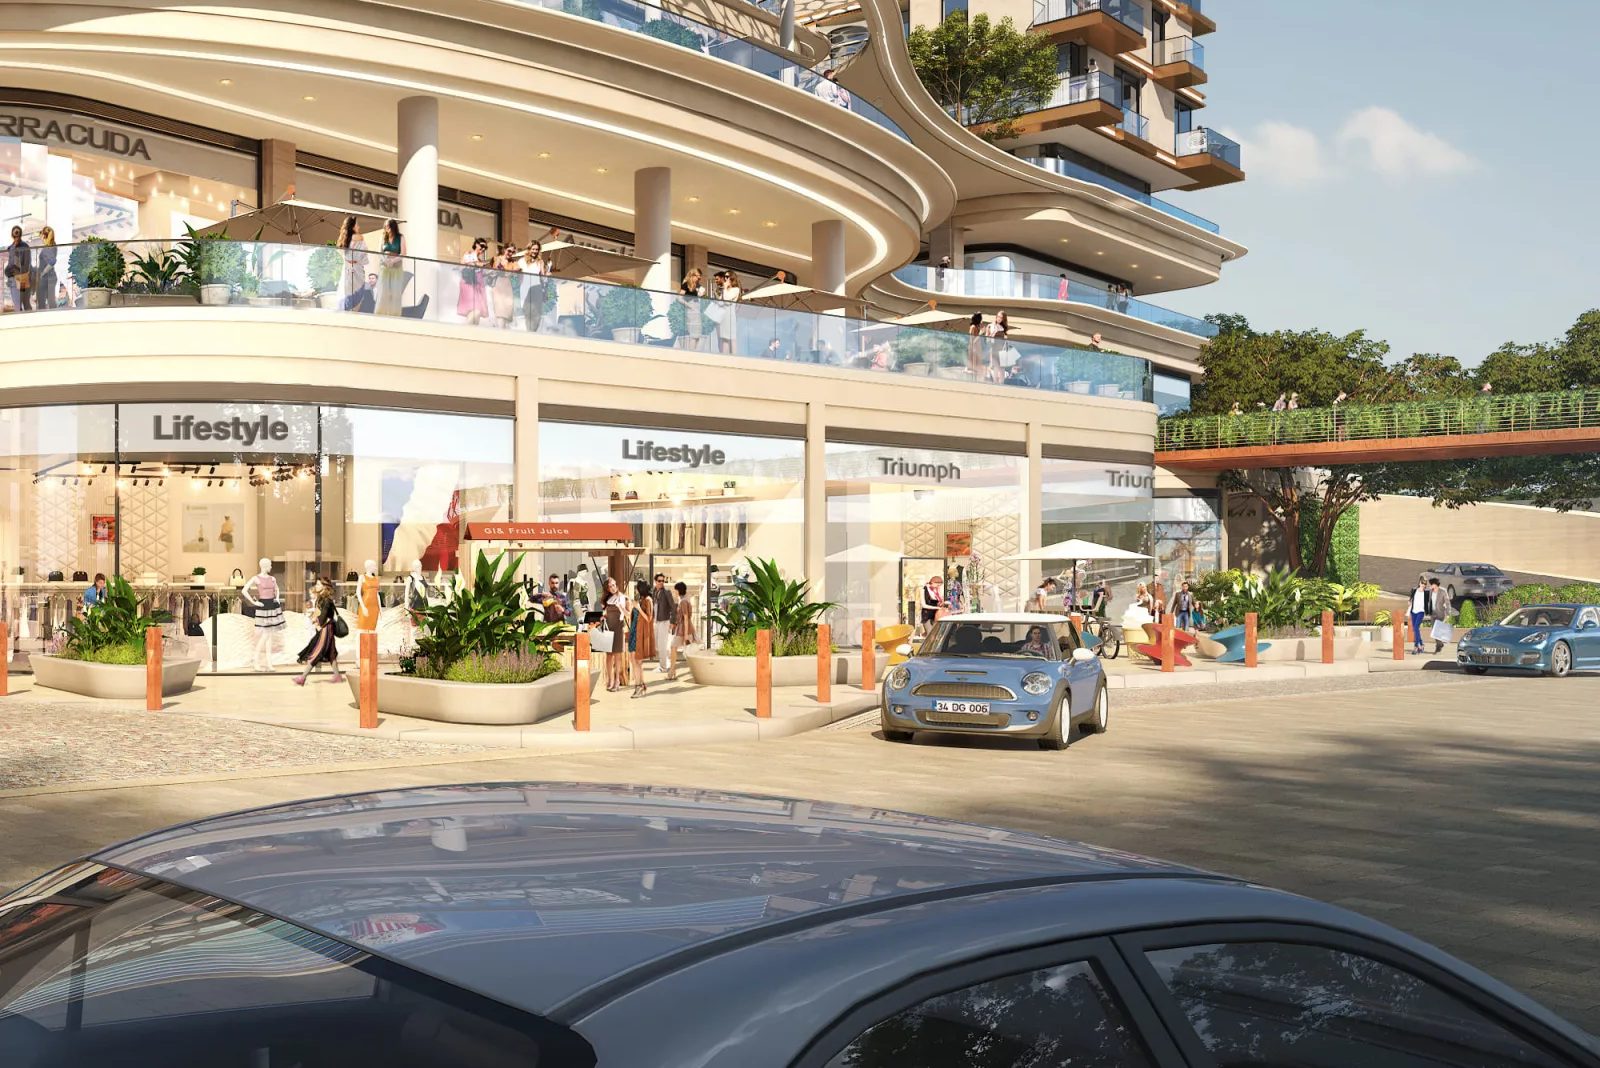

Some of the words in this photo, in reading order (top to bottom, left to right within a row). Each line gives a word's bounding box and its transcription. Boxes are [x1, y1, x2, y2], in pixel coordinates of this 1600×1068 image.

[349, 187, 463, 230] BARRDA
[153, 415, 289, 446] Lifestyle
[622, 439, 725, 468] Lifestyle
[878, 457, 961, 483] Triumph
[508, 527, 536, 535] Fruit
[540, 527, 570, 535] Juice
[937, 702, 949, 711] 34
[951, 703, 967, 712] DG
[969, 704, 988, 713] 006
